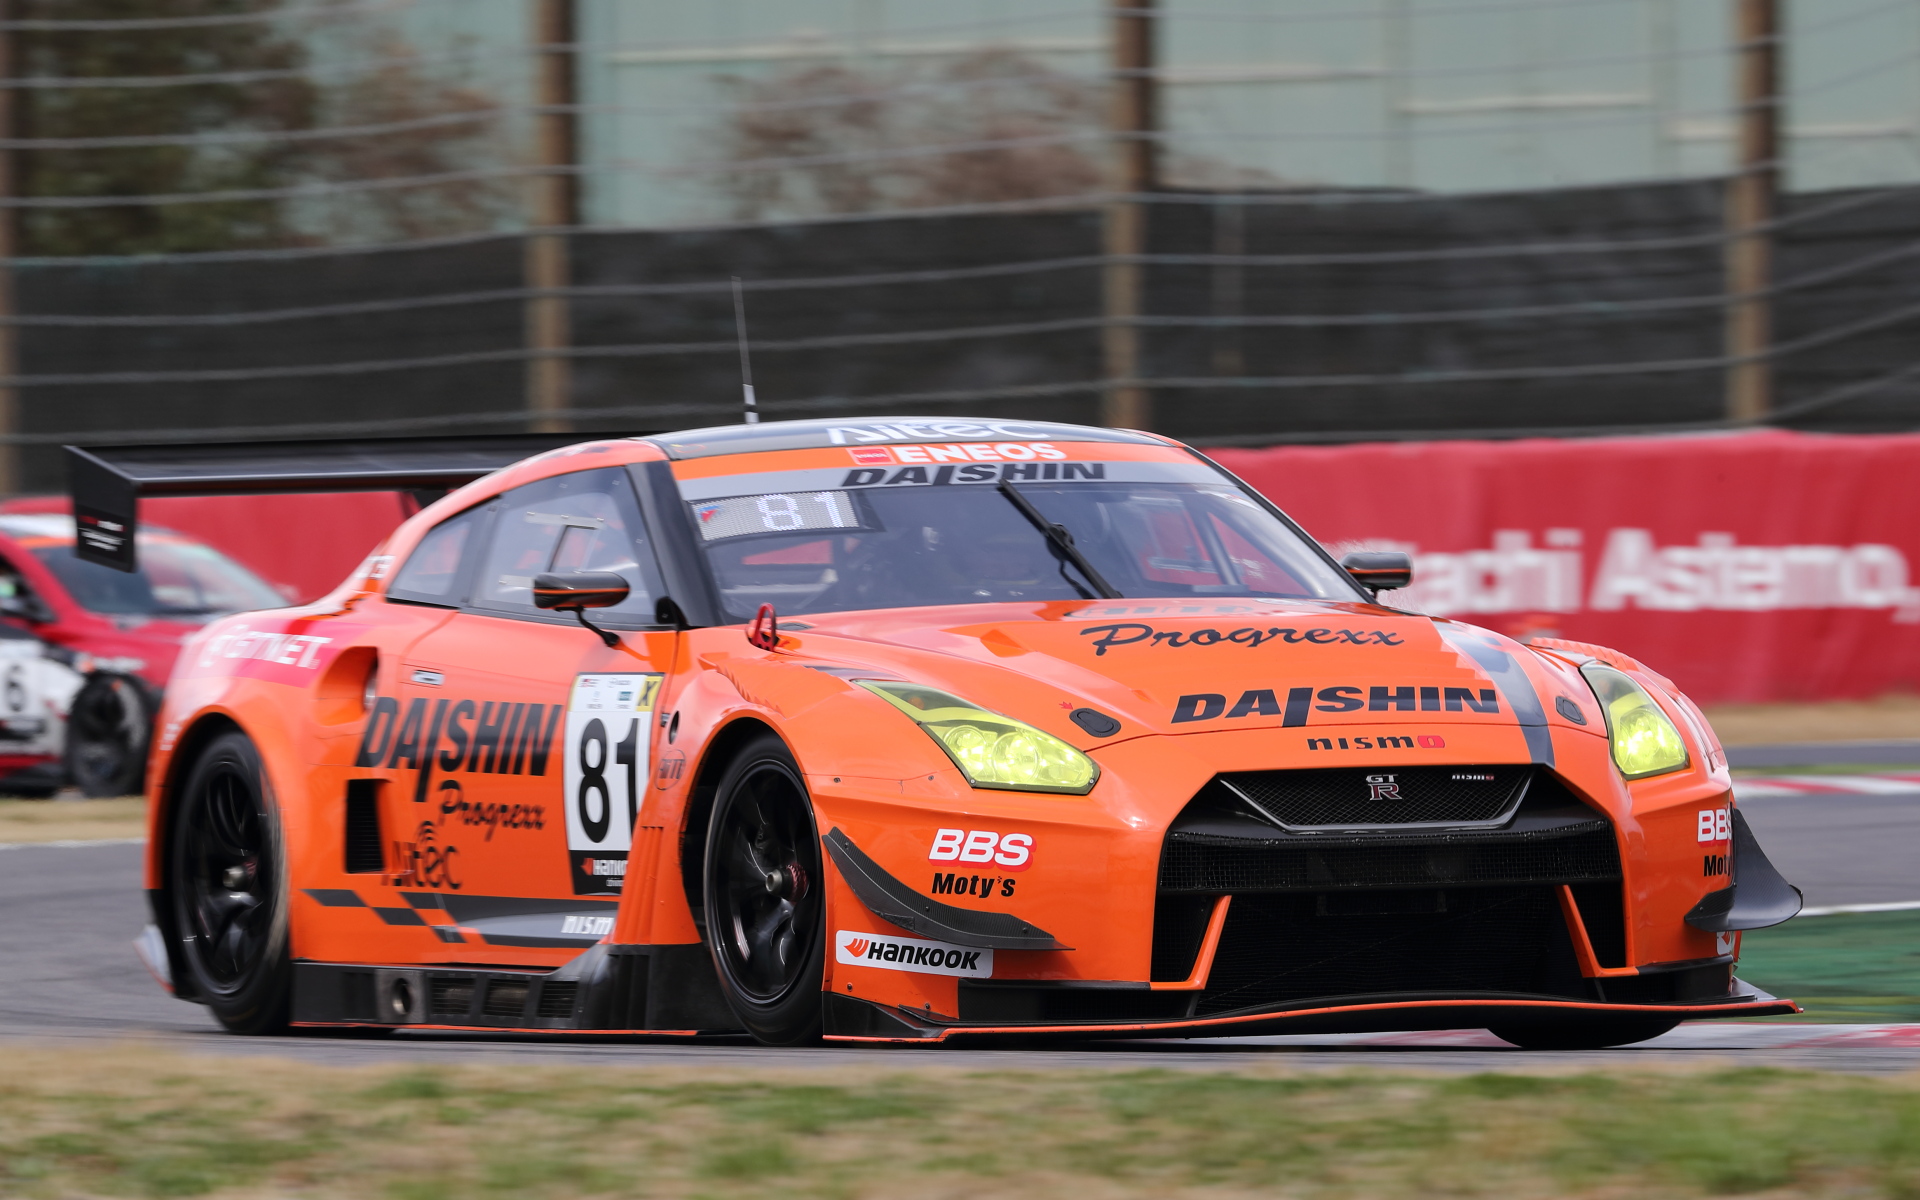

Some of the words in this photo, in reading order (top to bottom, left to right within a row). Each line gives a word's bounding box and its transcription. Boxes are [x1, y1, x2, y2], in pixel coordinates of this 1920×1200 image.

[892, 442, 1067, 463] ENEOS
[842, 463, 1106, 487] DAISHIN
[756, 492, 845, 531] 81
[1079, 623, 1405, 656] Progrexx
[1171, 686, 1500, 728] DAISHIN
[355, 696, 564, 802] DAISHIN
[1307, 734, 1445, 751] nismo
[578, 717, 640, 844] 81
[1365, 774, 1398, 783] GT
[1367, 783, 1402, 801] R
[437, 779, 547, 842] Progrexx
[929, 828, 1035, 869] BBS
[931, 872, 1016, 898] Moty's
[561, 916, 615, 935] nism
[867, 940, 981, 970] HANKOOK
